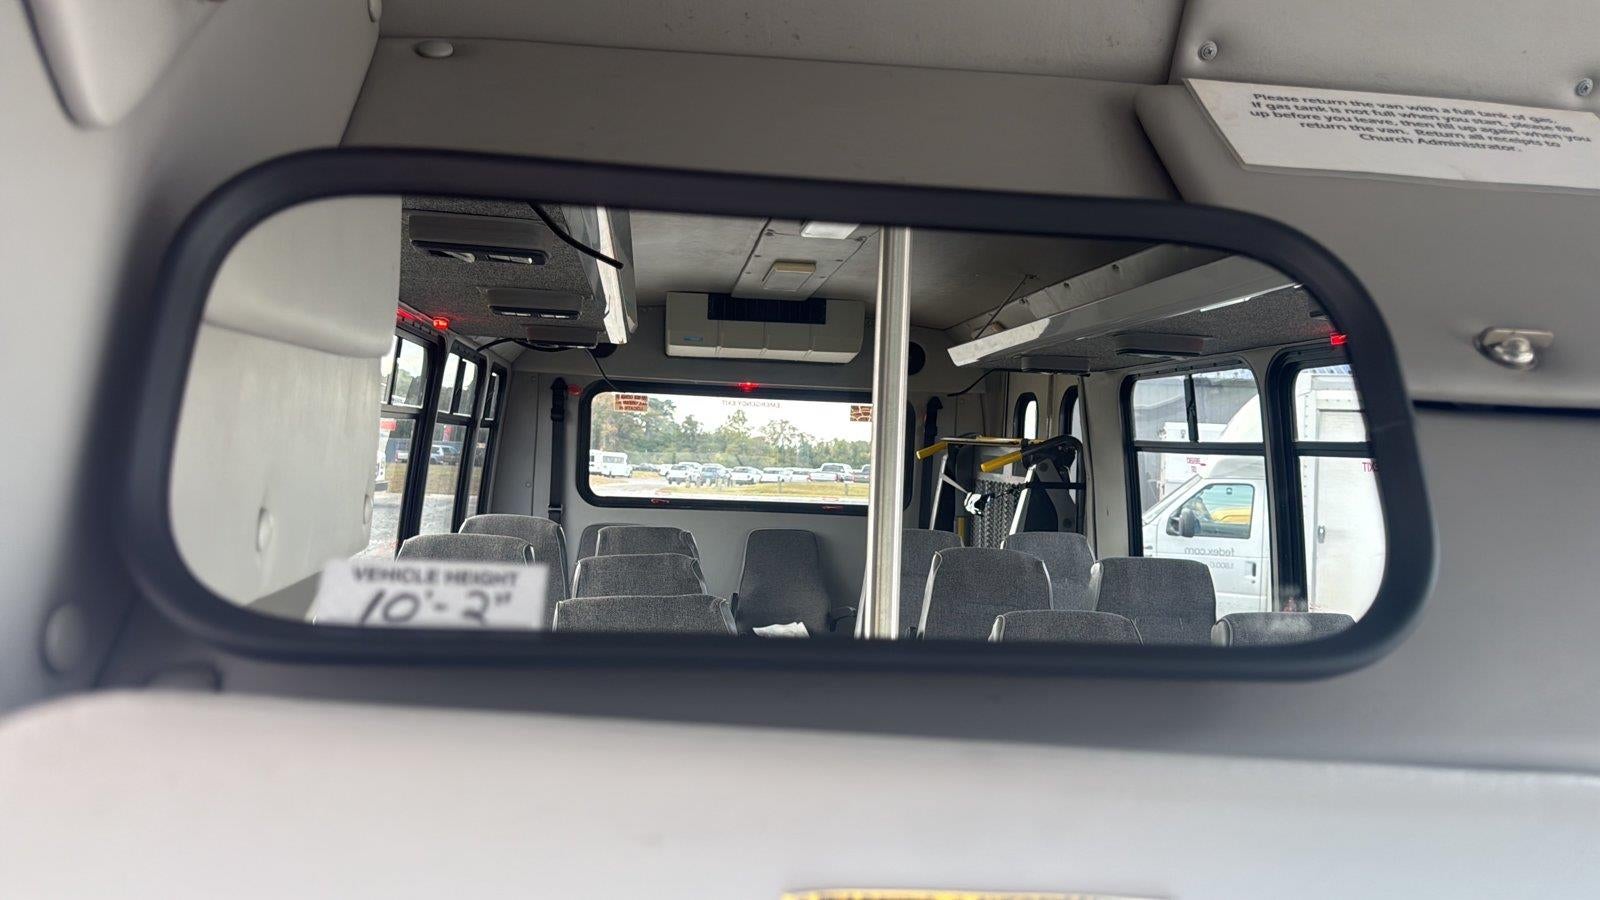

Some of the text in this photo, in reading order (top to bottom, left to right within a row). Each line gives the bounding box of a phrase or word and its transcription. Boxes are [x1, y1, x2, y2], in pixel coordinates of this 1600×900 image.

[1253, 94, 1299, 103] Please
[1303, 98, 1347, 106] return
[1351, 100, 1374, 108] the
[1406, 105, 1438, 113] with
[1453, 108, 1475, 116] full
[1478, 111, 1509, 119] tank
[1294, 104, 1325, 112] tank
[1345, 108, 1369, 116] not
[1373, 109, 1395, 117] full
[1399, 112, 1440, 120] when
[1510, 122, 1553, 131] please
[1273, 111, 1321, 120] before
[1400, 120, 1434, 128] then
[1522, 131, 1561, 139] when
[1300, 122, 1346, 131] return
[1415, 129, 1465, 139] Return
[1488, 136, 1542, 145] receipts
[1359, 134, 1413, 144] Church
[352, 566, 519, 586] VEHICLE HEIGHT
